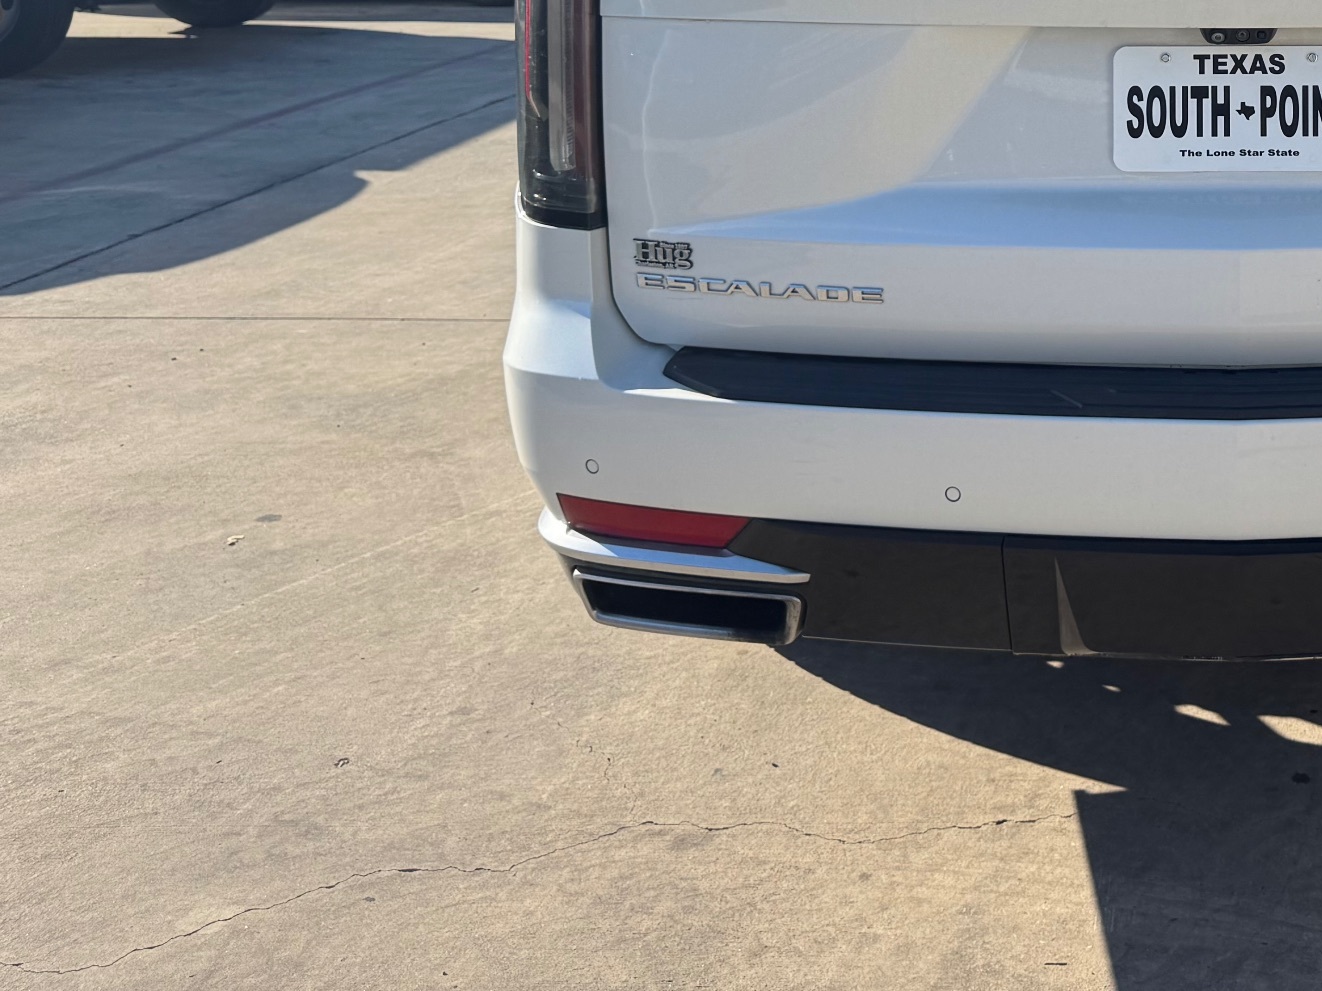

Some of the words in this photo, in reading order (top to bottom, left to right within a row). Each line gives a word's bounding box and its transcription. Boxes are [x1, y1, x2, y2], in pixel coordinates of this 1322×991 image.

[1193, 54, 1286, 75] TEXAS
[1126, 85, 1231, 139] SOUTH
[1179, 149, 1202, 157] The
[1206, 149, 1236, 157] Lone
[1239, 149, 1265, 157] Star
[1268, 149, 1300, 157] State
[634, 239, 692, 270] Hug
[636, 272, 884, 304] ESCALADE
